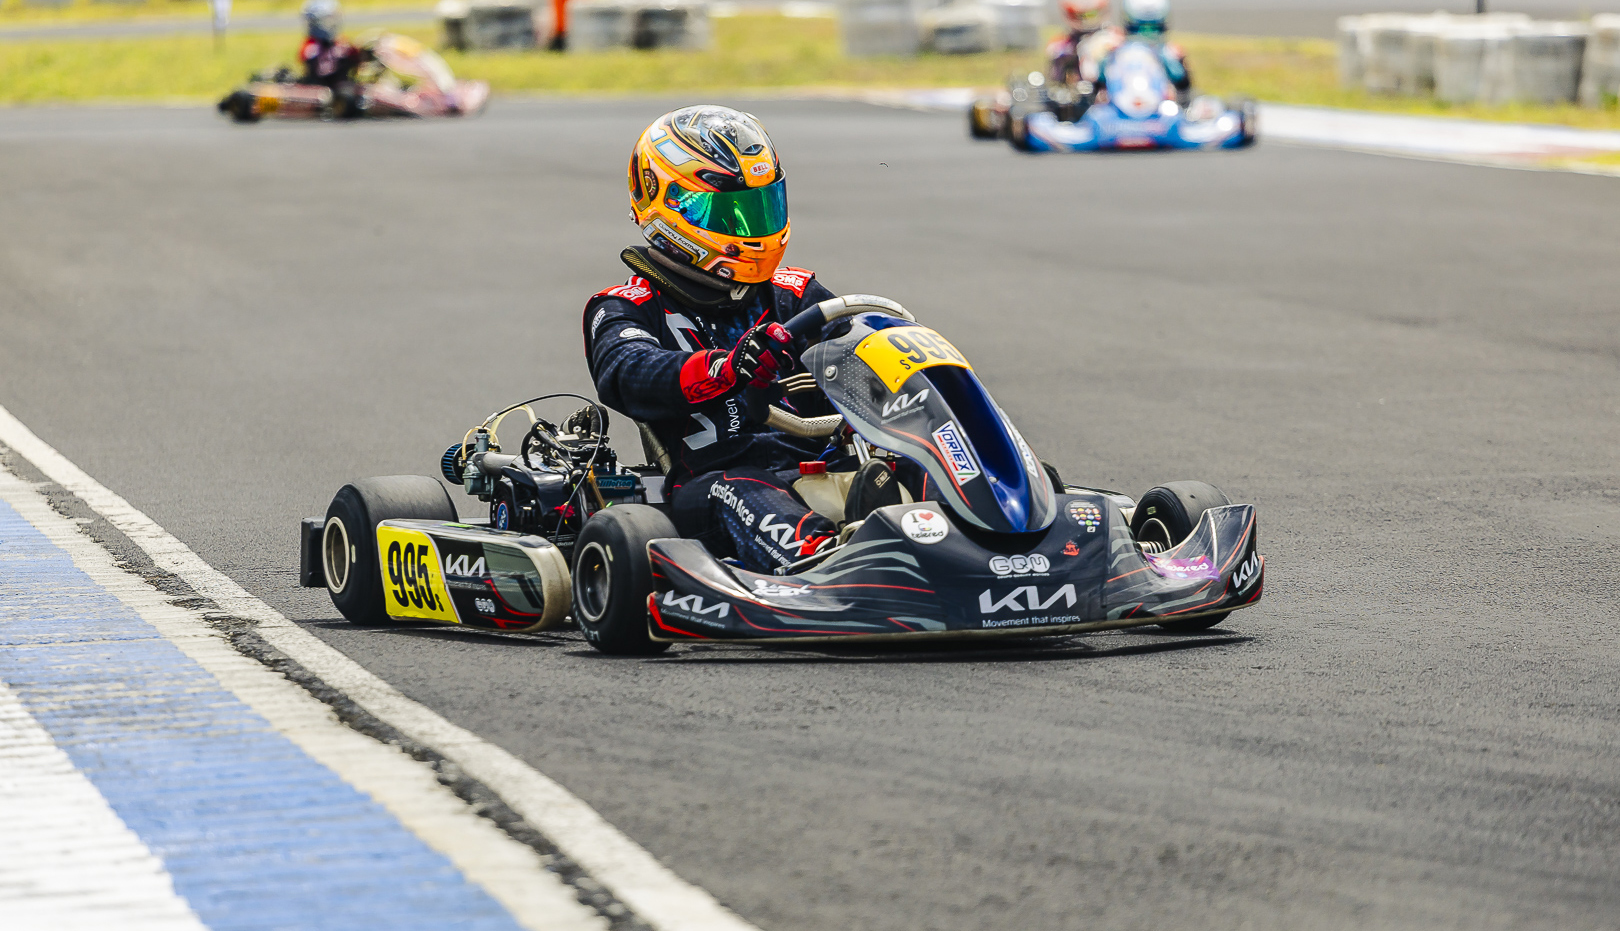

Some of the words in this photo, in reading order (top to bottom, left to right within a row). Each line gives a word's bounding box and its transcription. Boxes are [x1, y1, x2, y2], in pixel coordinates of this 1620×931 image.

[753, 164, 768, 172] BELL
[774, 275, 803, 286] OMP
[888, 331, 966, 363] 995
[882, 389, 929, 417] KIA
[938, 424, 975, 471] VORTEX
[910, 513, 919, 523] I
[759, 514, 806, 558] KIA
[911, 530, 944, 538] telered
[388, 541, 437, 611] 995
[446, 554, 485, 577] KIA
[990, 555, 1049, 574] GQM
[1233, 551, 1258, 588] KIA
[663, 590, 730, 618] KIA
[979, 584, 1078, 614] KIA
[982, 617, 1030, 628] Movement
[1032, 615, 1049, 624] that
[1050, 614, 1081, 624] inspires
